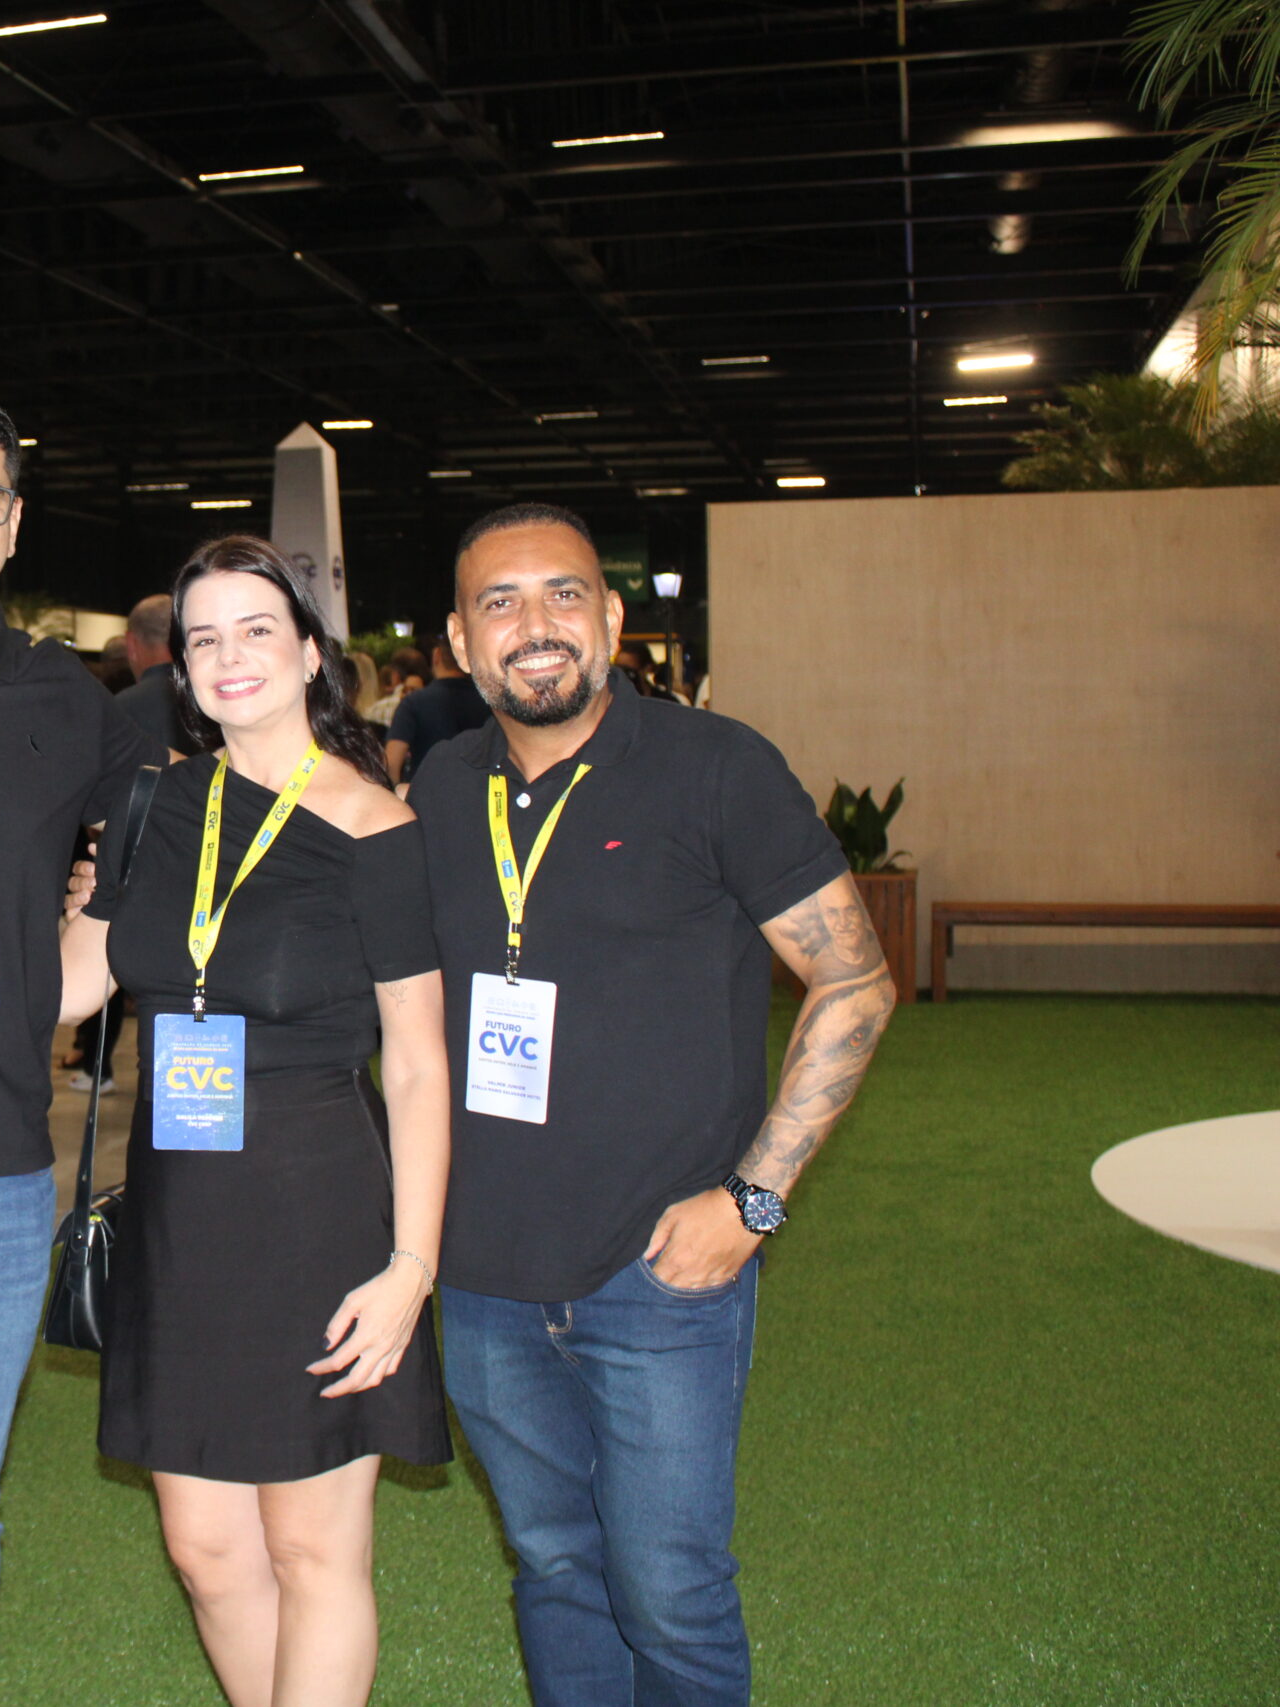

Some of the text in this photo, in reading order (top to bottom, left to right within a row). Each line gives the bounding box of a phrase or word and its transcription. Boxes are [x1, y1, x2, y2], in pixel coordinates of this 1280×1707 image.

[207, 811, 216, 831] CVC
[274, 801, 291, 822] CVC
[486, 1020, 522, 1032] FUTURO
[479, 1031, 539, 1061] CVC
[173, 1056, 215, 1066] FUTURO
[166, 1066, 234, 1091] CVC
